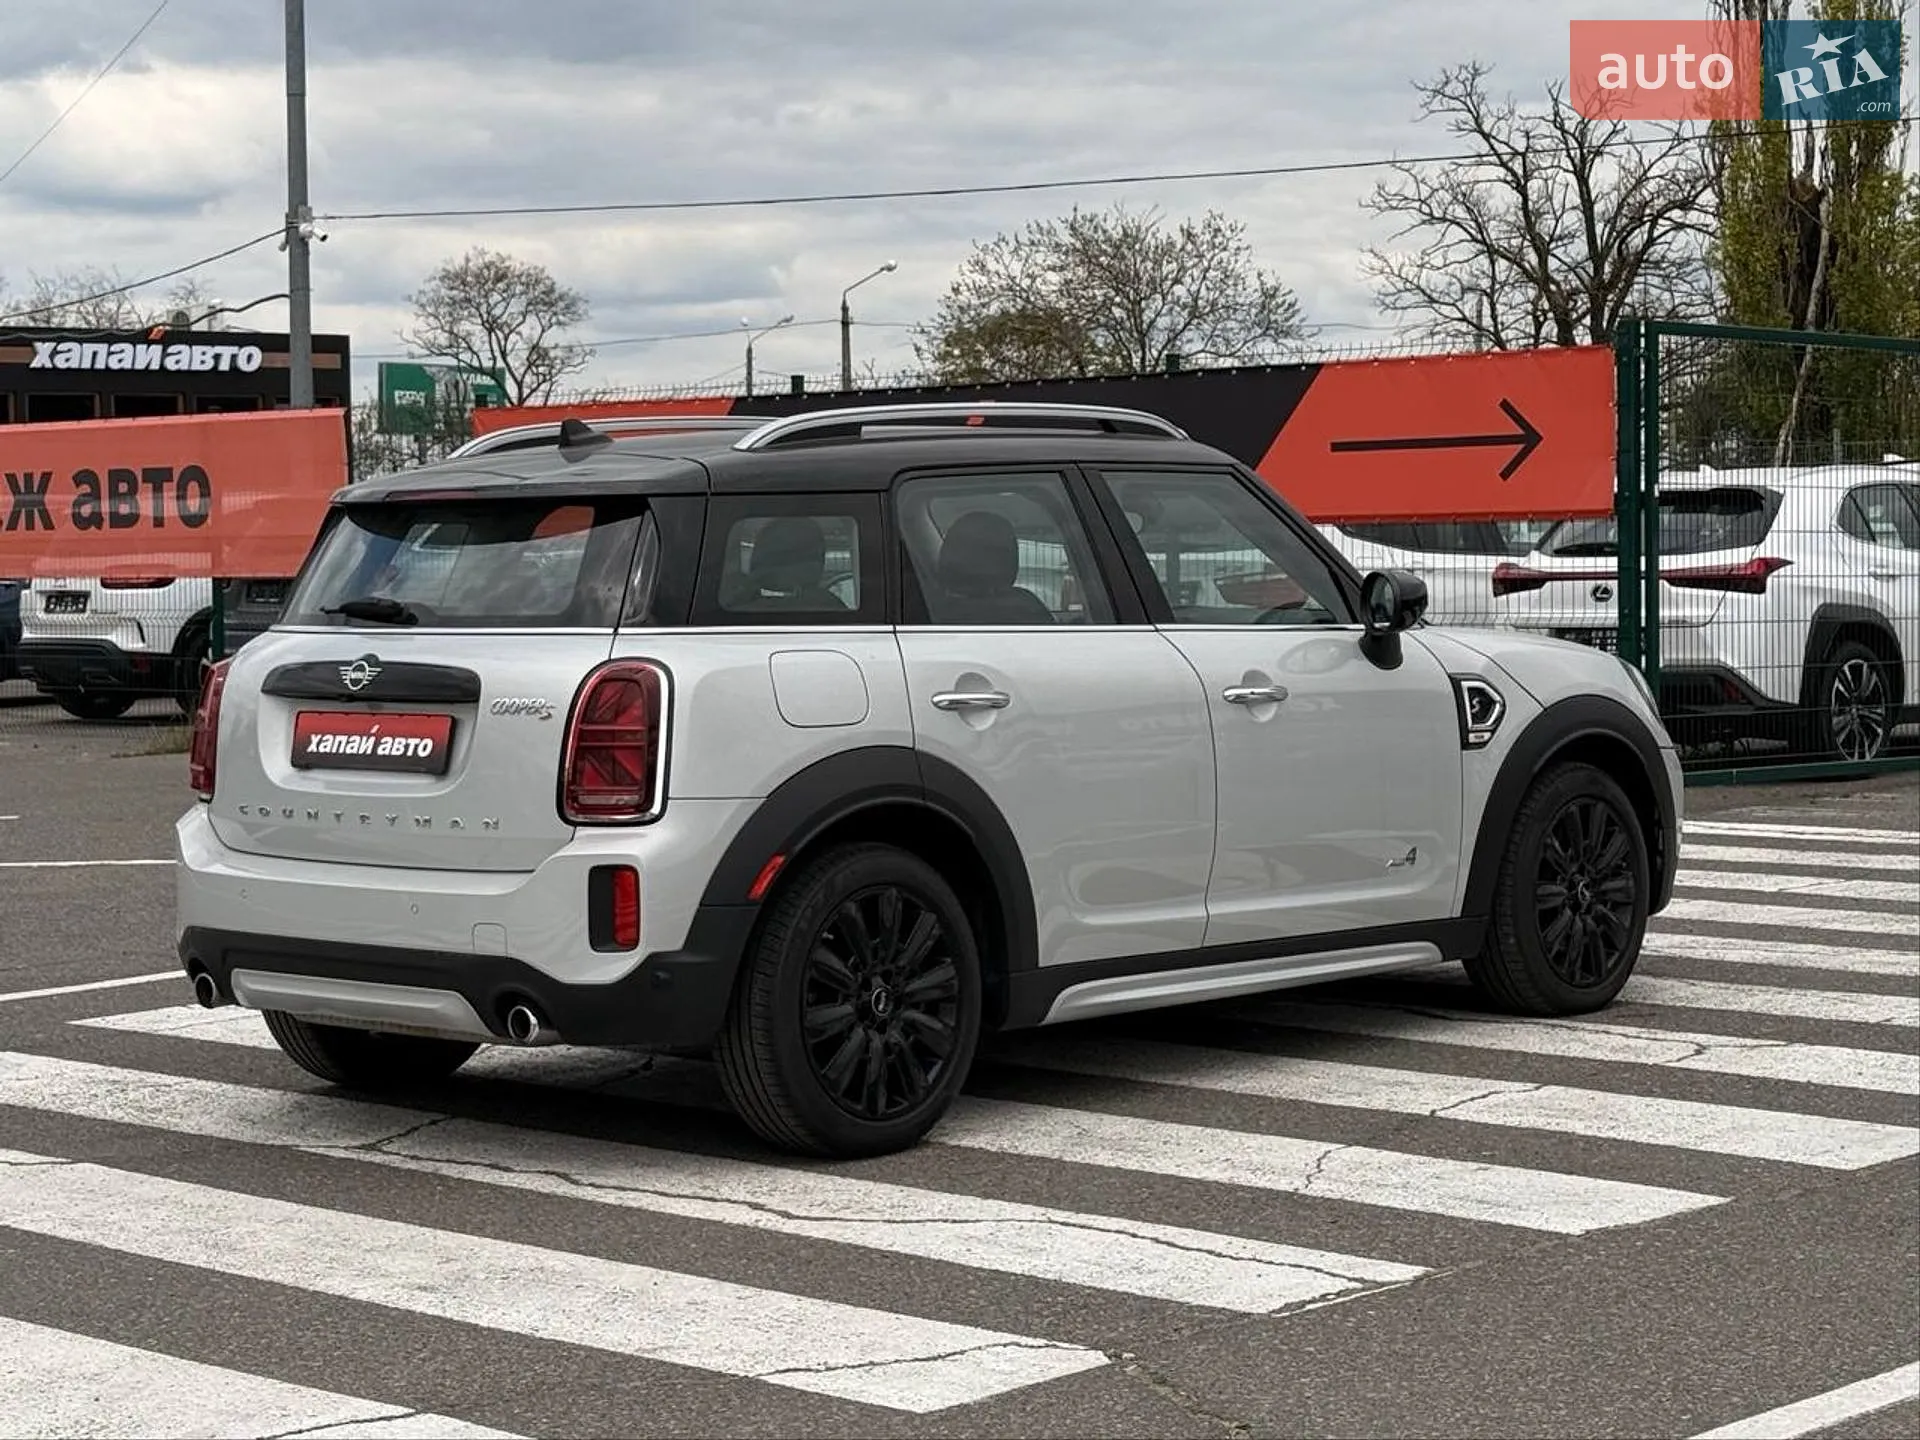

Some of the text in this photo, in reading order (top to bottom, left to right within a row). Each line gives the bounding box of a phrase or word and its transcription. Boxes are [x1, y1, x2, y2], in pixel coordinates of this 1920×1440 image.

[163, 344, 263, 372] авто
[0, 465, 211, 531] ж авто
[377, 736, 434, 758] авто
[238, 804, 499, 831] COUNTRYMAN
